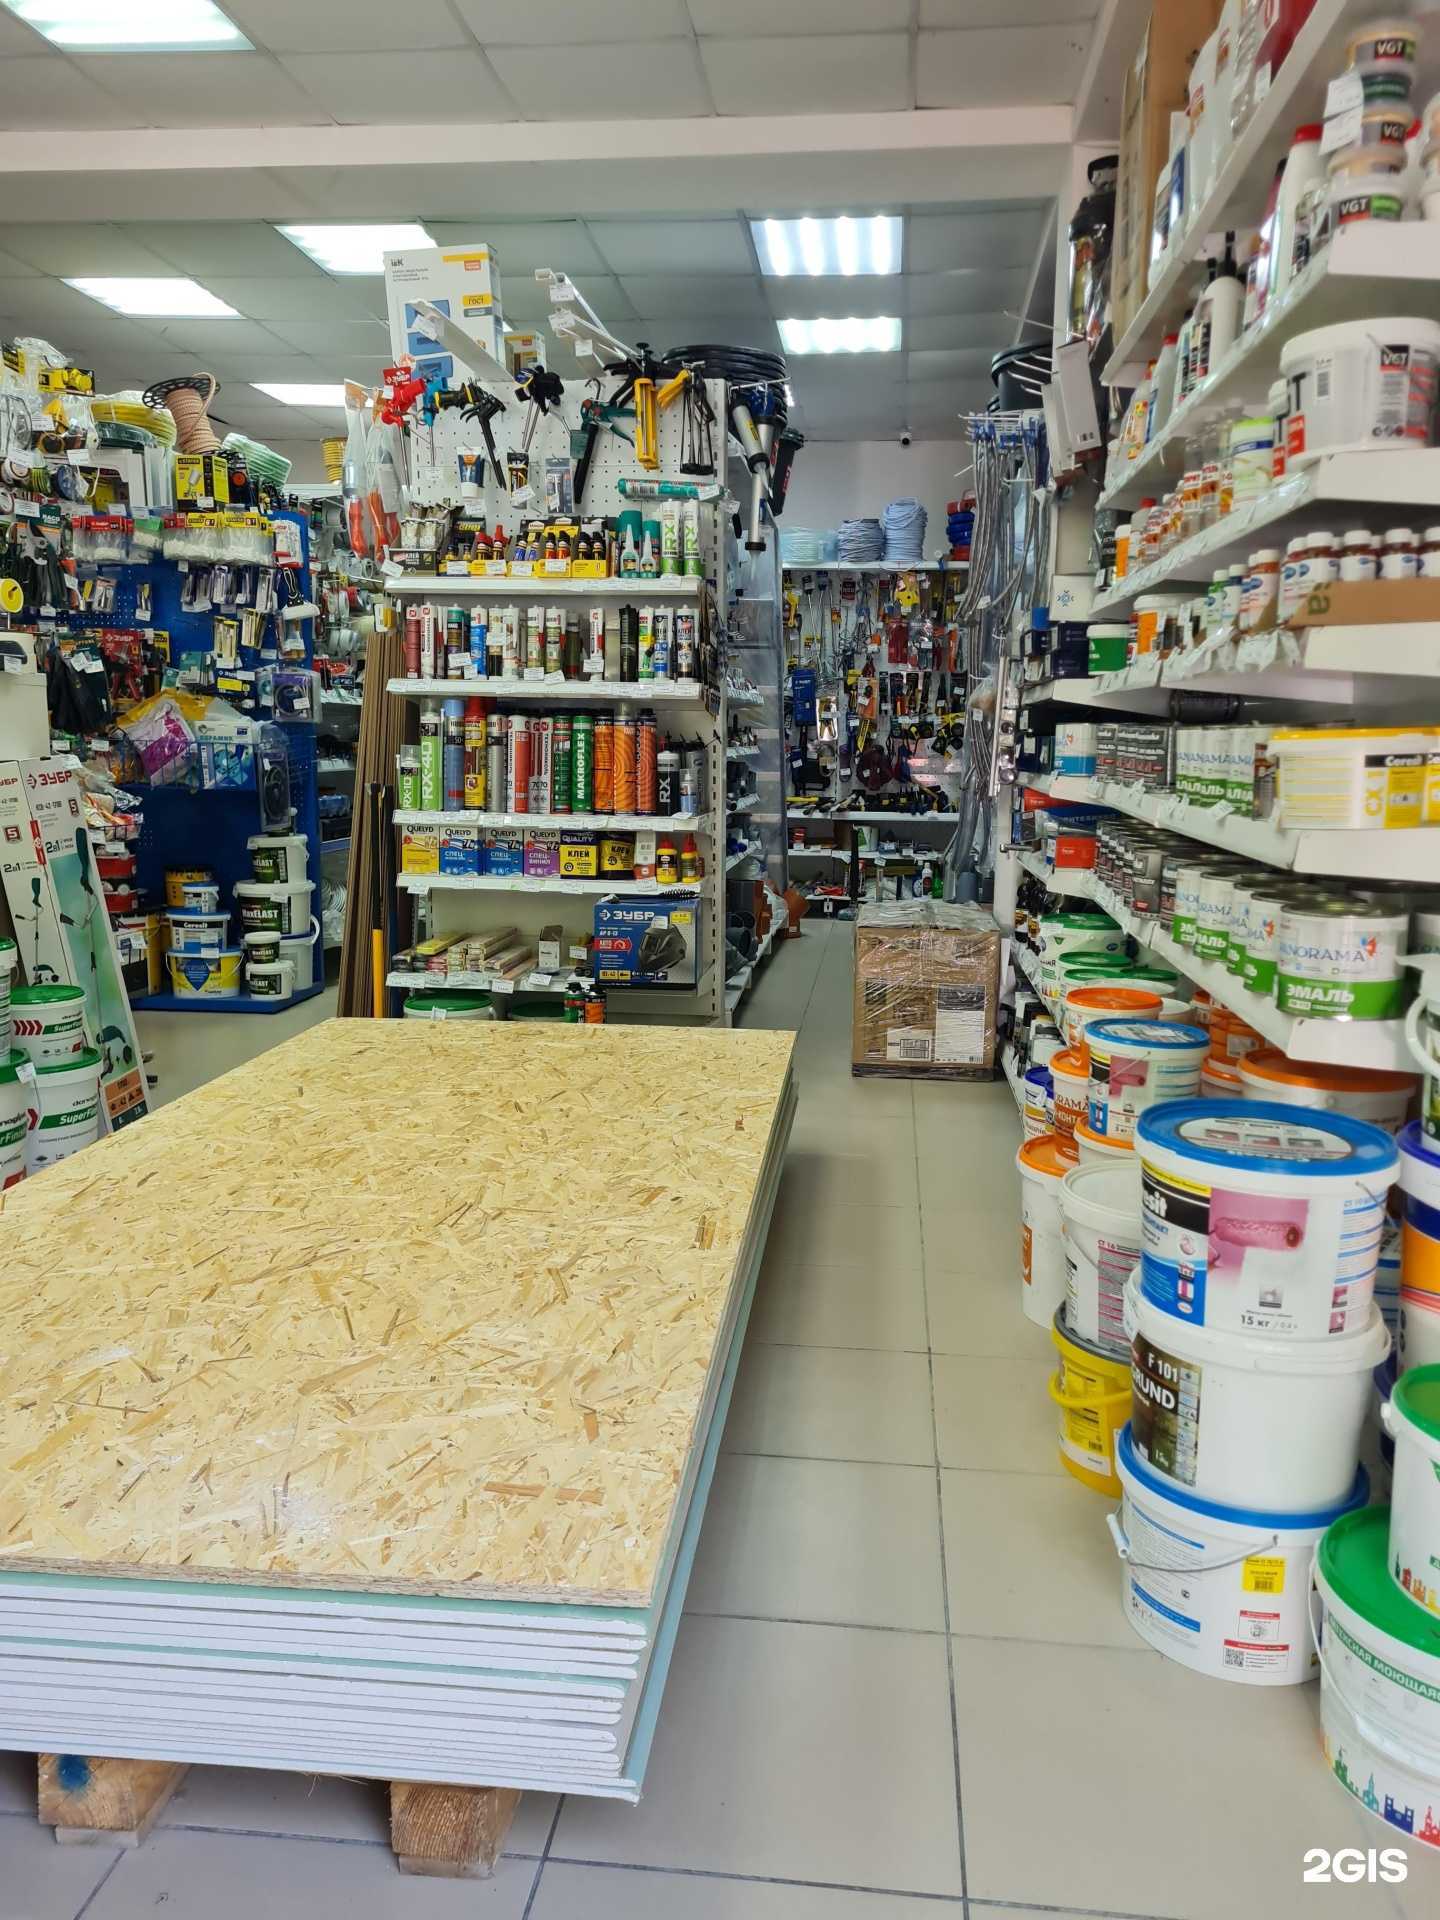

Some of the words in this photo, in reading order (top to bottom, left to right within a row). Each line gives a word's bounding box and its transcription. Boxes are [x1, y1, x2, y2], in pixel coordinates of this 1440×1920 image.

[1377, 42, 1403, 55] VGT
[1341, 198, 1368, 215] VGT
[576, 732, 585, 799] MAKROFLEX
[39, 770, 73, 786] ЗУБР
[659, 778, 671, 802] RX
[567, 849, 590, 858] КЛЕЙ
[613, 911, 655, 920] ЗУБР
[1286, 983, 1355, 1003] ЭМАЛЬ
[1240, 1314, 1255, 1326] 15
[1256, 1318, 1272, 1329] кг
[1147, 1352, 1156, 1368] F
[1157, 1359, 1179, 1384] 101
